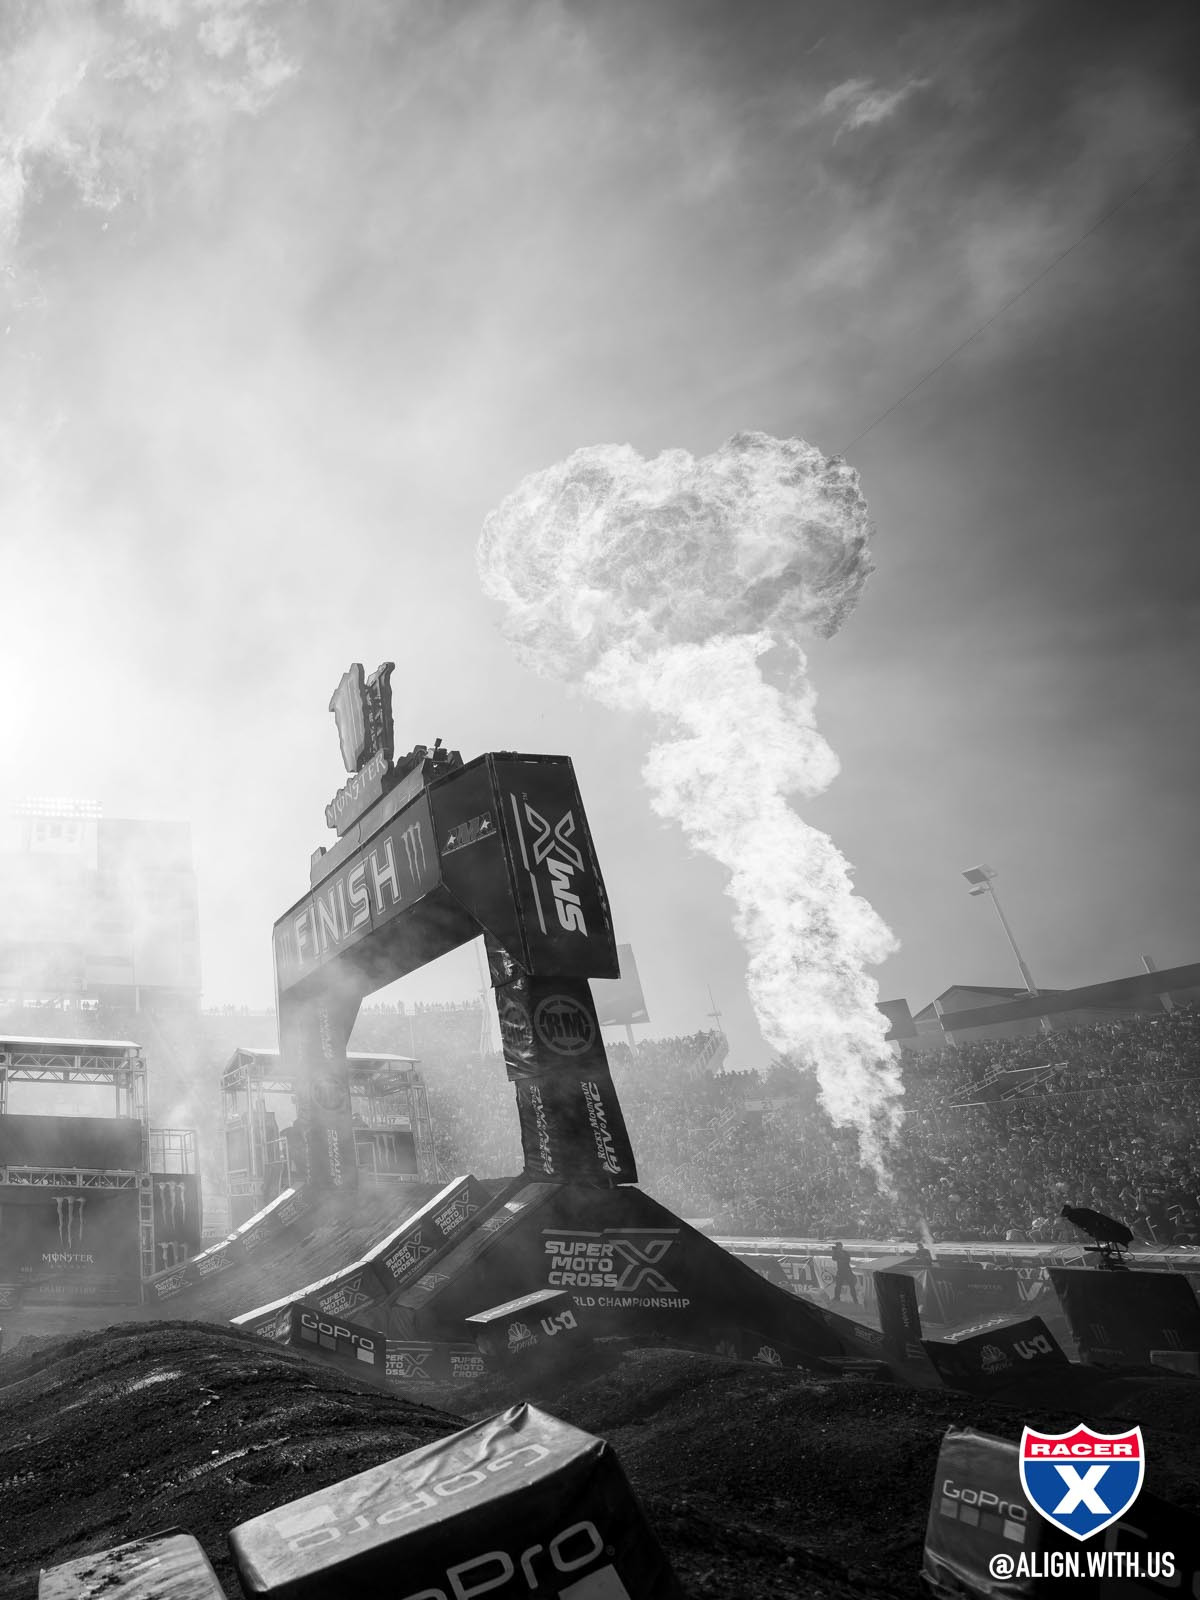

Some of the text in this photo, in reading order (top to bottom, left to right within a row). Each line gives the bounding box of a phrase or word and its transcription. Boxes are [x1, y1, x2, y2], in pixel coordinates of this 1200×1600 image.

[294, 836, 402, 964] FINISH
[434, 1205, 457, 1226] SUPER
[439, 1210, 459, 1229] MOTO
[443, 1214, 464, 1235] CROSS
[42, 1251, 94, 1264] MONSTER
[385, 1246, 408, 1268] SUPER
[545, 1240, 614, 1257] SUPER
[391, 1251, 411, 1272] MOTO
[393, 1256, 416, 1278] CROSS
[551, 1256, 614, 1272] MOTO
[548, 1271, 618, 1288] CROSS
[319, 1290, 344, 1308] SUPER
[323, 1296, 346, 1312] MOTO
[573, 1296, 690, 1309] RLD CHAMPIONSHIP
[301, 1313, 374, 1350] GoPro
[386, 1354, 404, 1362] PER
[942, 1479, 1028, 1521] GoPro
[402, 1519, 604, 1600] Pro
